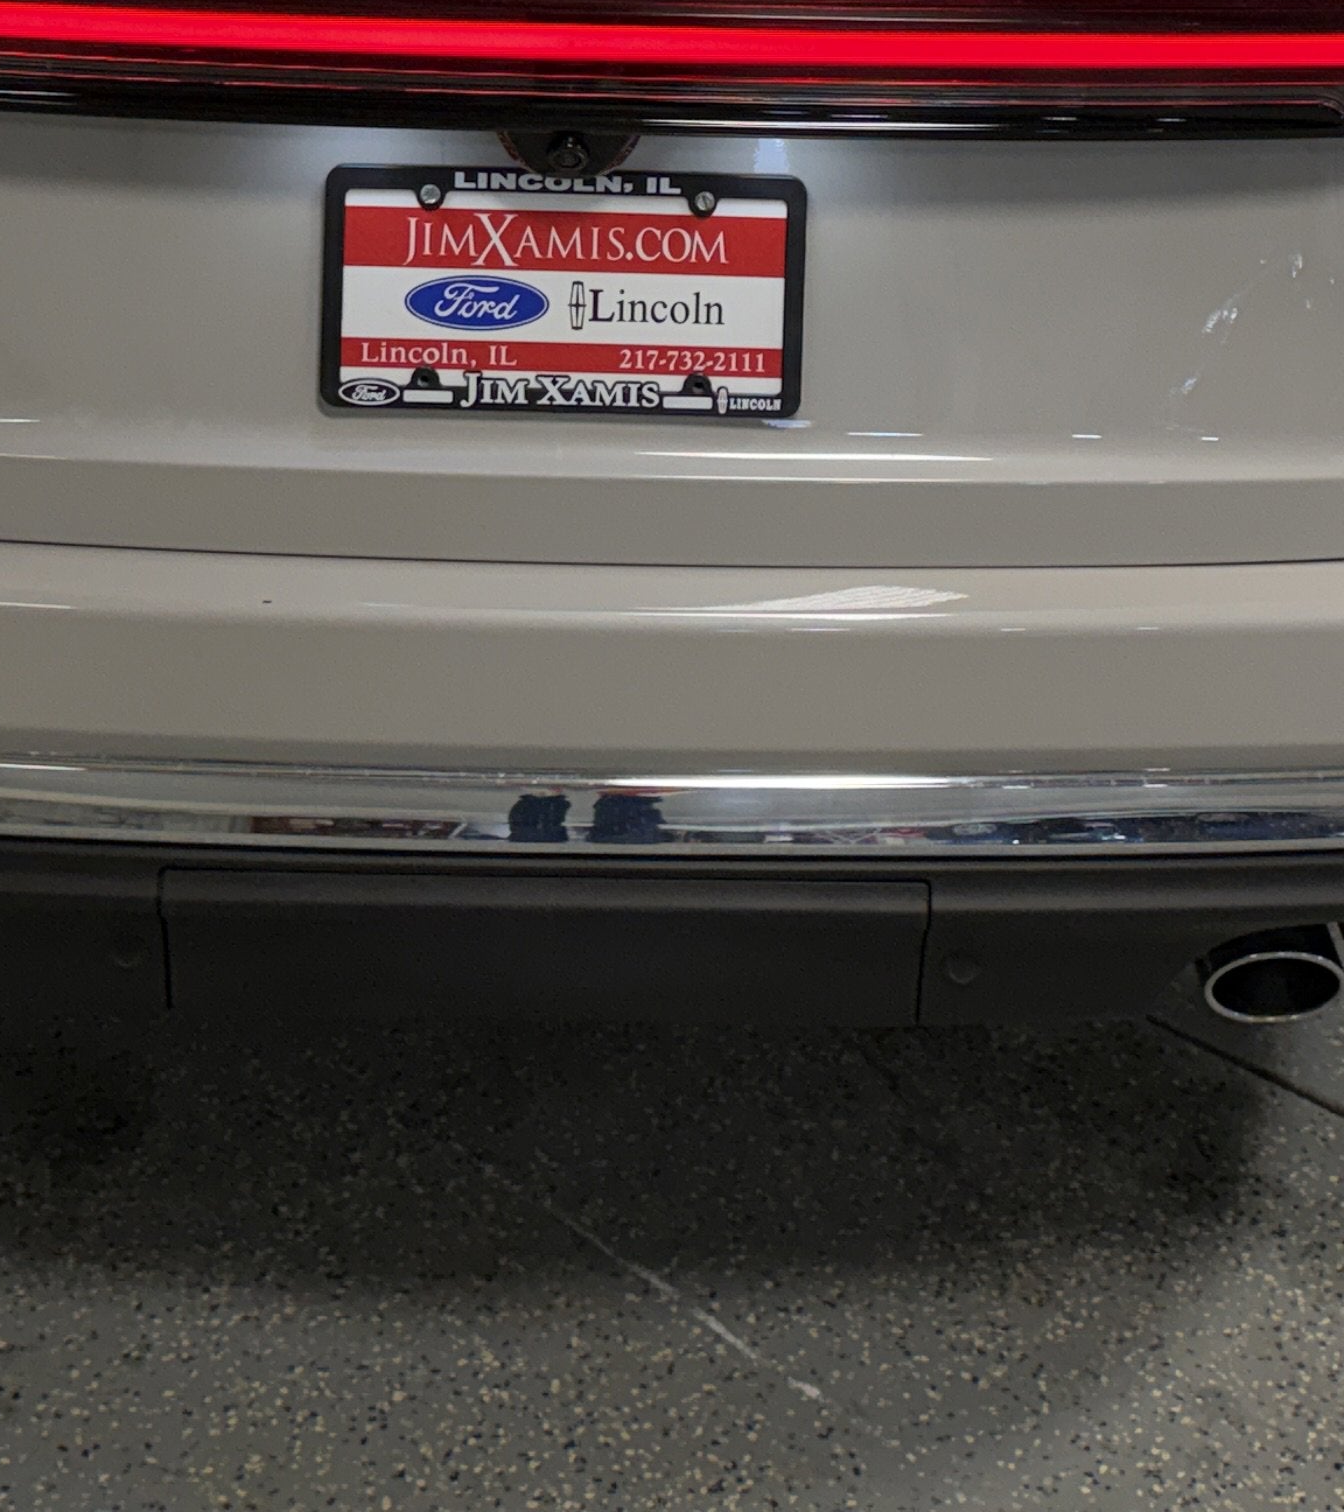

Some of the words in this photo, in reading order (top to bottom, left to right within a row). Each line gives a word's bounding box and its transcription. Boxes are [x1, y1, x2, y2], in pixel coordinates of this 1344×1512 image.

[454, 171, 635, 193] LINCOLN,
[645, 176, 682, 195] IL
[403, 211, 730, 267] JIMXAMIS.COM
[434, 281, 520, 320] Ford
[588, 288, 725, 326] Lincoln
[360, 341, 478, 369] Lincoln,
[489, 344, 518, 367] IL
[618, 348, 766, 374] 217-732-2111
[350, 385, 388, 403] Ford
[459, 371, 529, 409] JIM
[536, 374, 661, 409] XAMIS
[727, 396, 783, 413] LINCOLN
